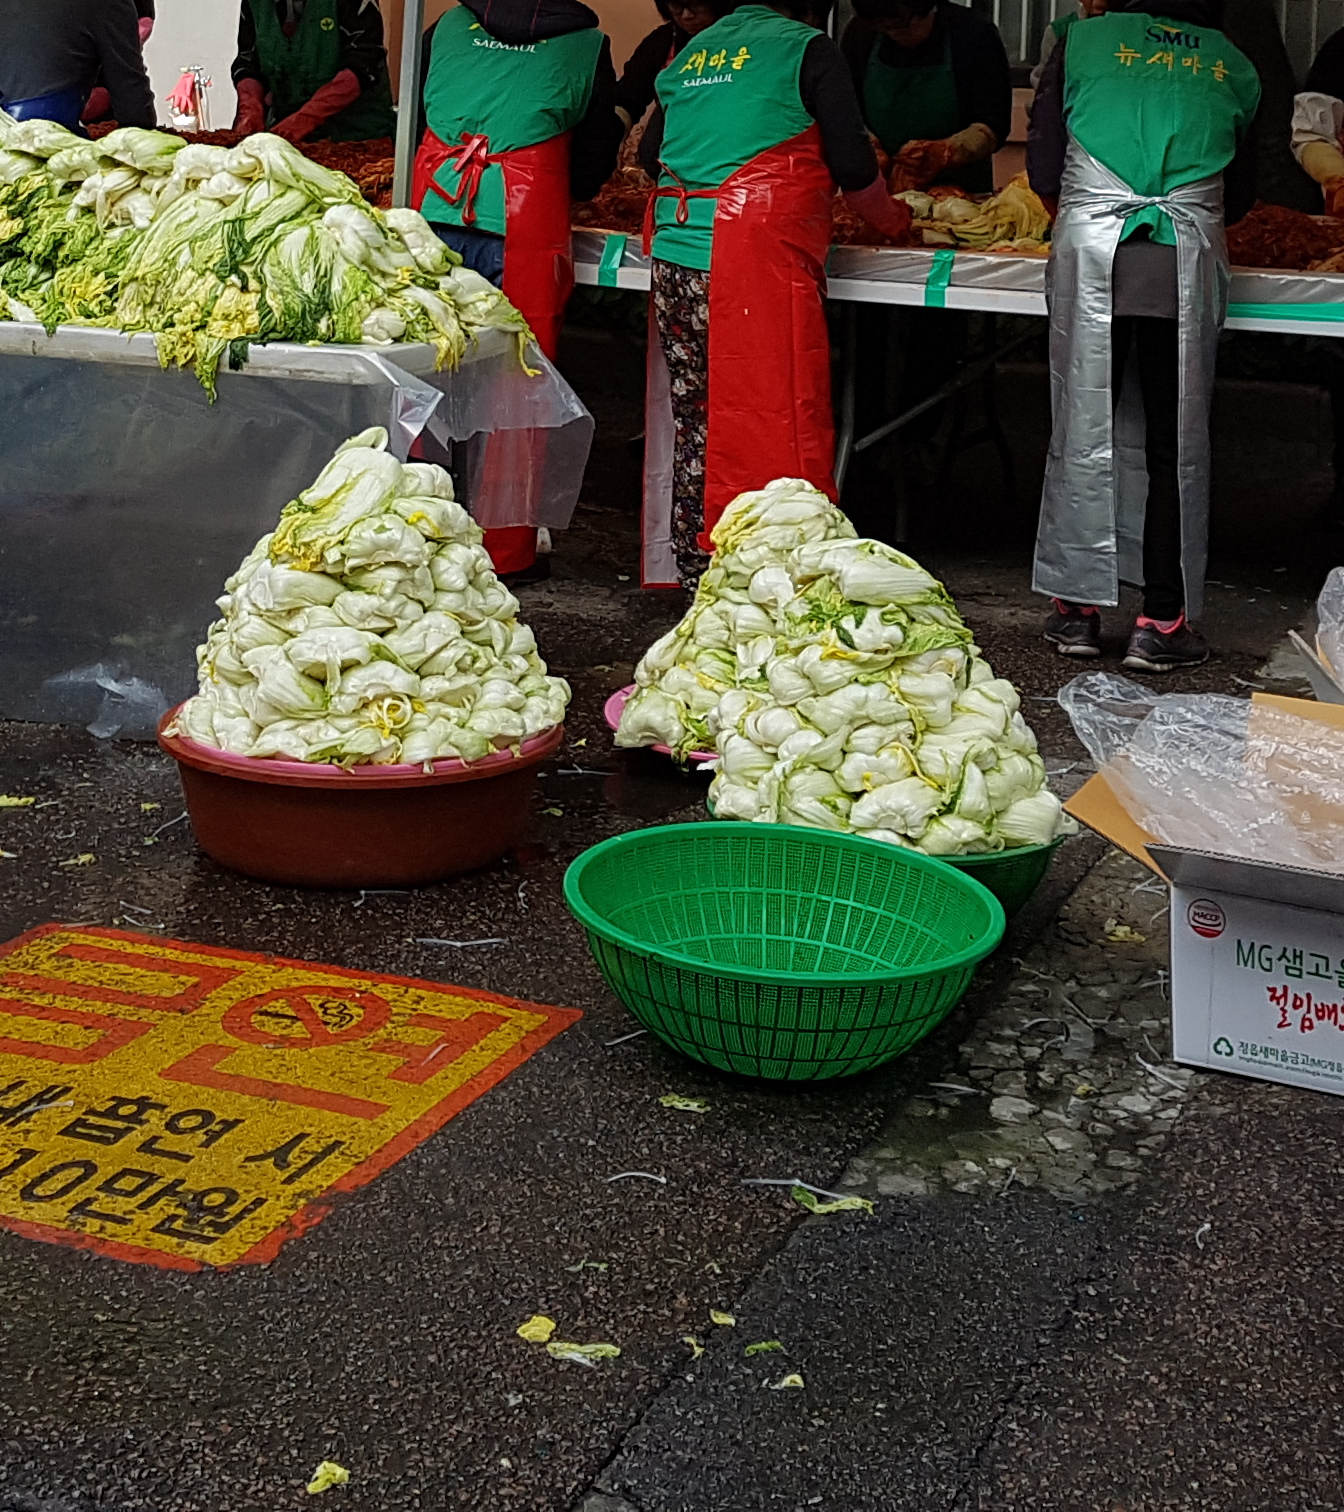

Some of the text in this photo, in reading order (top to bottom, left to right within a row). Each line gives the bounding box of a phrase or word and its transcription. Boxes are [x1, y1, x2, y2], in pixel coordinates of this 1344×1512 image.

[471, 37, 537, 54] SAEMAUL
[1145, 25, 1201, 50] SMU
[678, 45, 751, 76] 새마을
[680, 73, 734, 89] SAEMAUL
[57, 1095, 247, 1164] 흡연
[243, 1131, 347, 1186] 시
